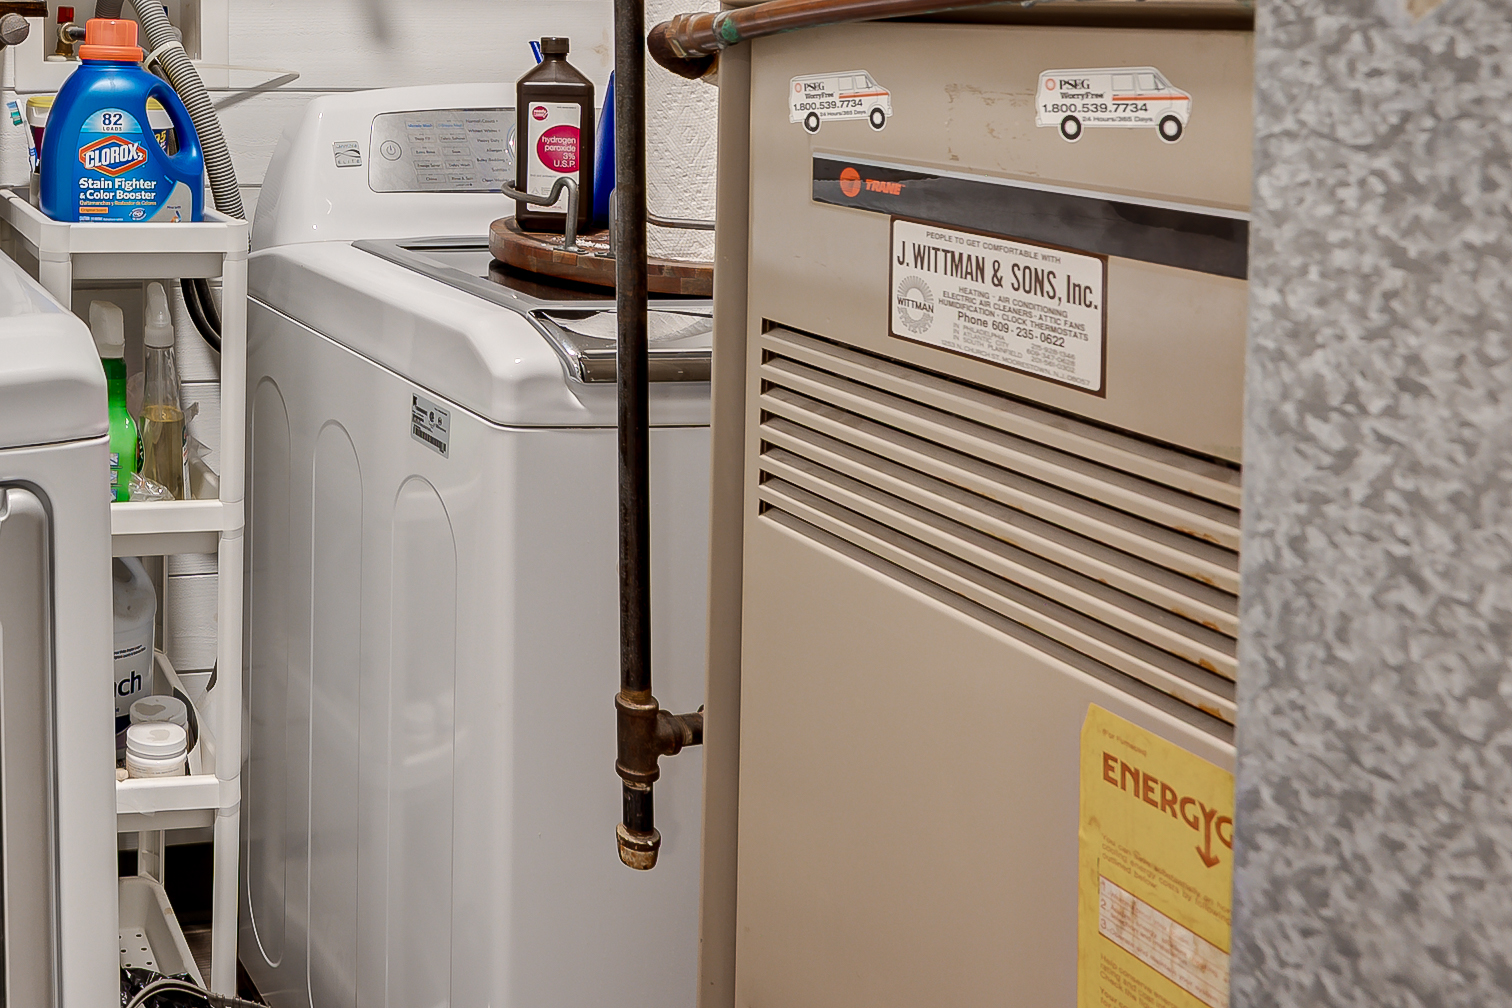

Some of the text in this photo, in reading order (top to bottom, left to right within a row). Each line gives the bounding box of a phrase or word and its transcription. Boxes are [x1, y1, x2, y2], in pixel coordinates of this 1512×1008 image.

[803, 81, 825, 92] PSEG
[1059, 78, 1090, 90] PSEG
[1060, 91, 1105, 101] WorryFree
[793, 99, 863, 111] 1.800.539.7734
[1042, 103, 1148, 113] 1.800.539.7734
[102, 113, 123, 126] 82
[541, 136, 576, 146] hydrogen
[562, 152, 576, 160] 3%
[553, 160, 576, 168] U.S.P.
[79, 177, 157, 191] Stain Fighter
[865, 179, 902, 196] TRANE
[86, 189, 115, 199] Color
[116, 190, 156, 200] Booster
[926, 231, 1061, 264] PEOPLE TO GET COMFORTABLE WITH
[912, 242, 985, 284] WITTMAN
[991, 259, 1003, 289] &
[1011, 263, 1062, 306] SONS,
[1066, 274, 1098, 310] Inc.
[897, 296, 934, 313] WITTMAN
[958, 286, 1068, 319] HEATING AIR CONDITIONING
[942, 290, 1085, 332] ELECTRIC AIR CLEANERS ATTIC FANS
[938, 298, 1089, 342] HUMIDIFICATION CLOCK THERMOSTATS
[957, 310, 988, 328] Phone
[1100, 898, 1107, 910] 2
[1100, 919, 1107, 930] 3
